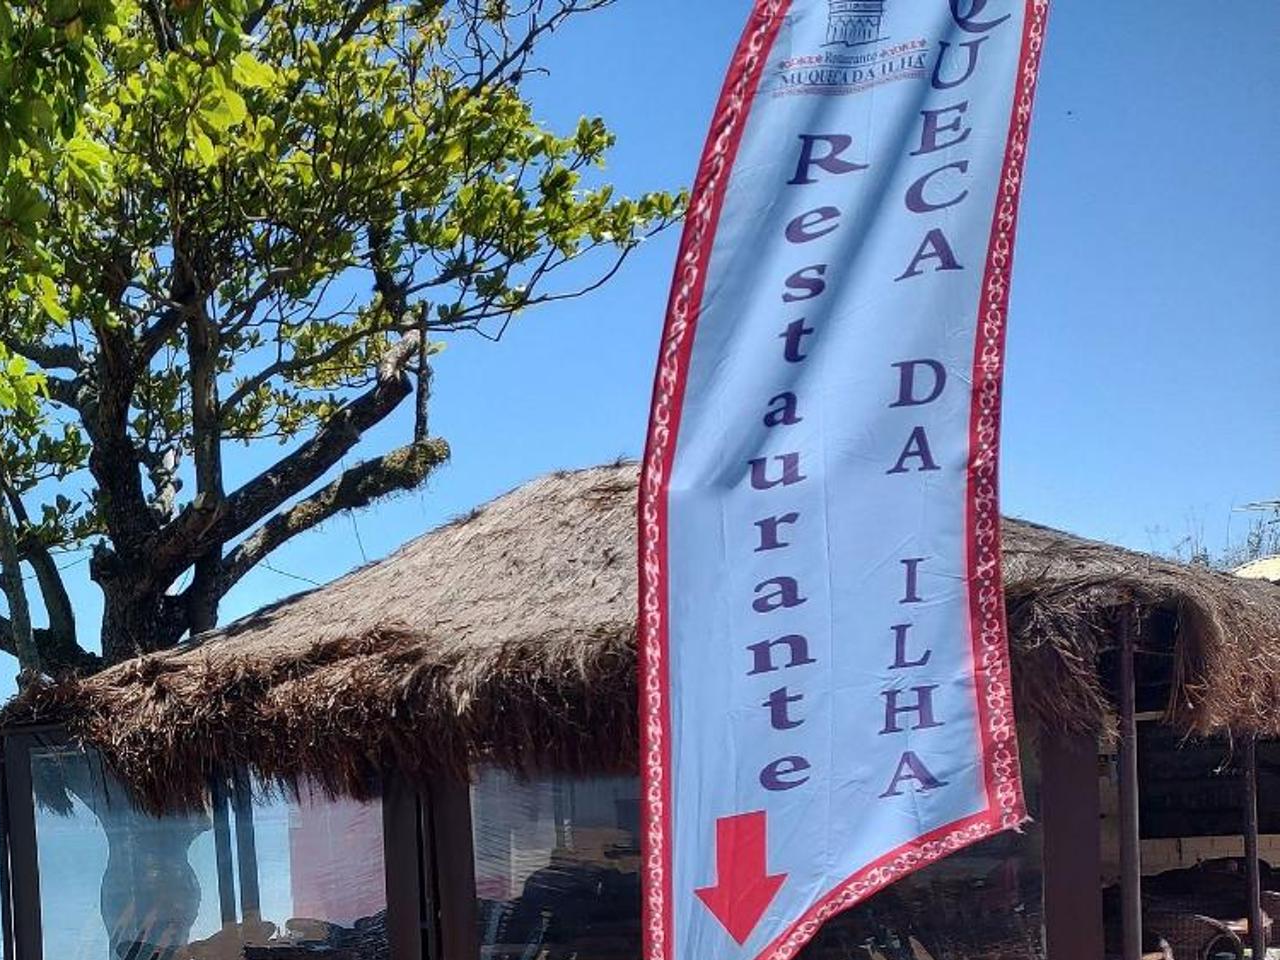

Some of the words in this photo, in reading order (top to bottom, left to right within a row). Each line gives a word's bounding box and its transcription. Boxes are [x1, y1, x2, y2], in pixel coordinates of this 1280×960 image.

[745, 133, 869, 792] Restaurante
[885, 358, 948, 475] DA
[878, 556, 950, 799] ILHA
